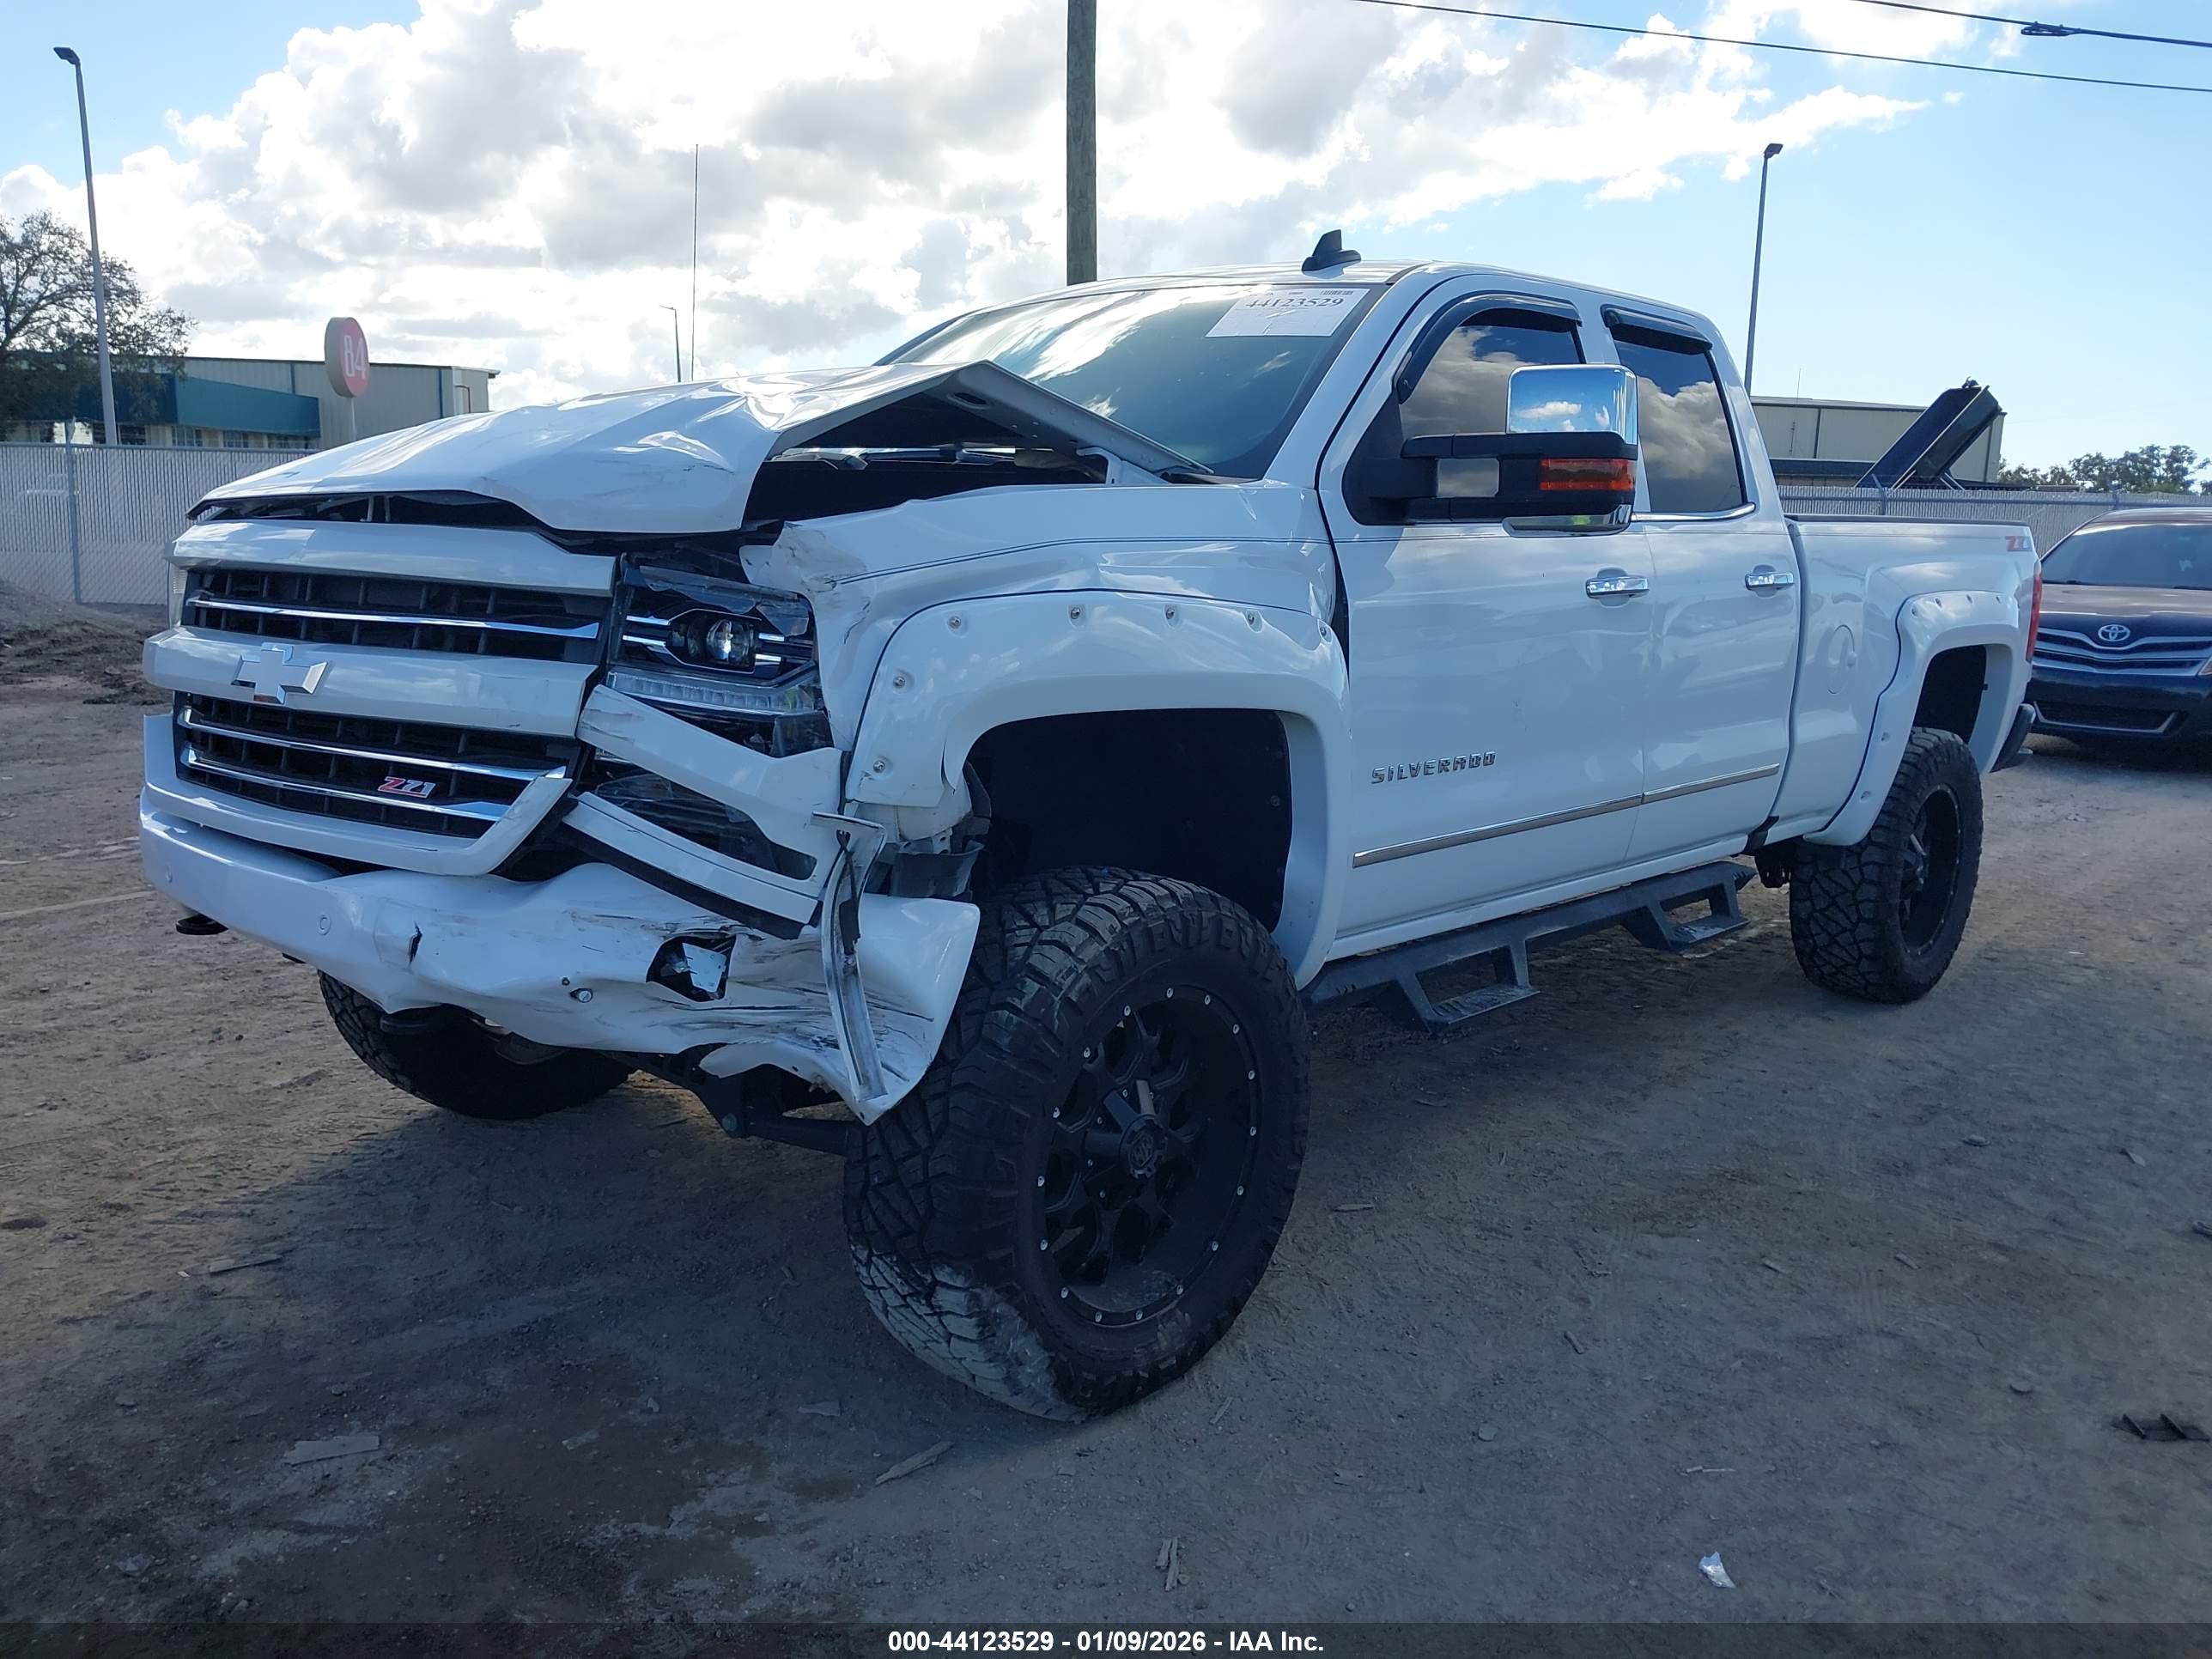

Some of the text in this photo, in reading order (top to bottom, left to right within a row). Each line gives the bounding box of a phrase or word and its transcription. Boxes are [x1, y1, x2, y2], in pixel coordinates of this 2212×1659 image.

[1246, 297, 1345, 308] 44123529
[1371, 750, 1497, 784] SILVERADO
[377, 776, 436, 798] Z71
